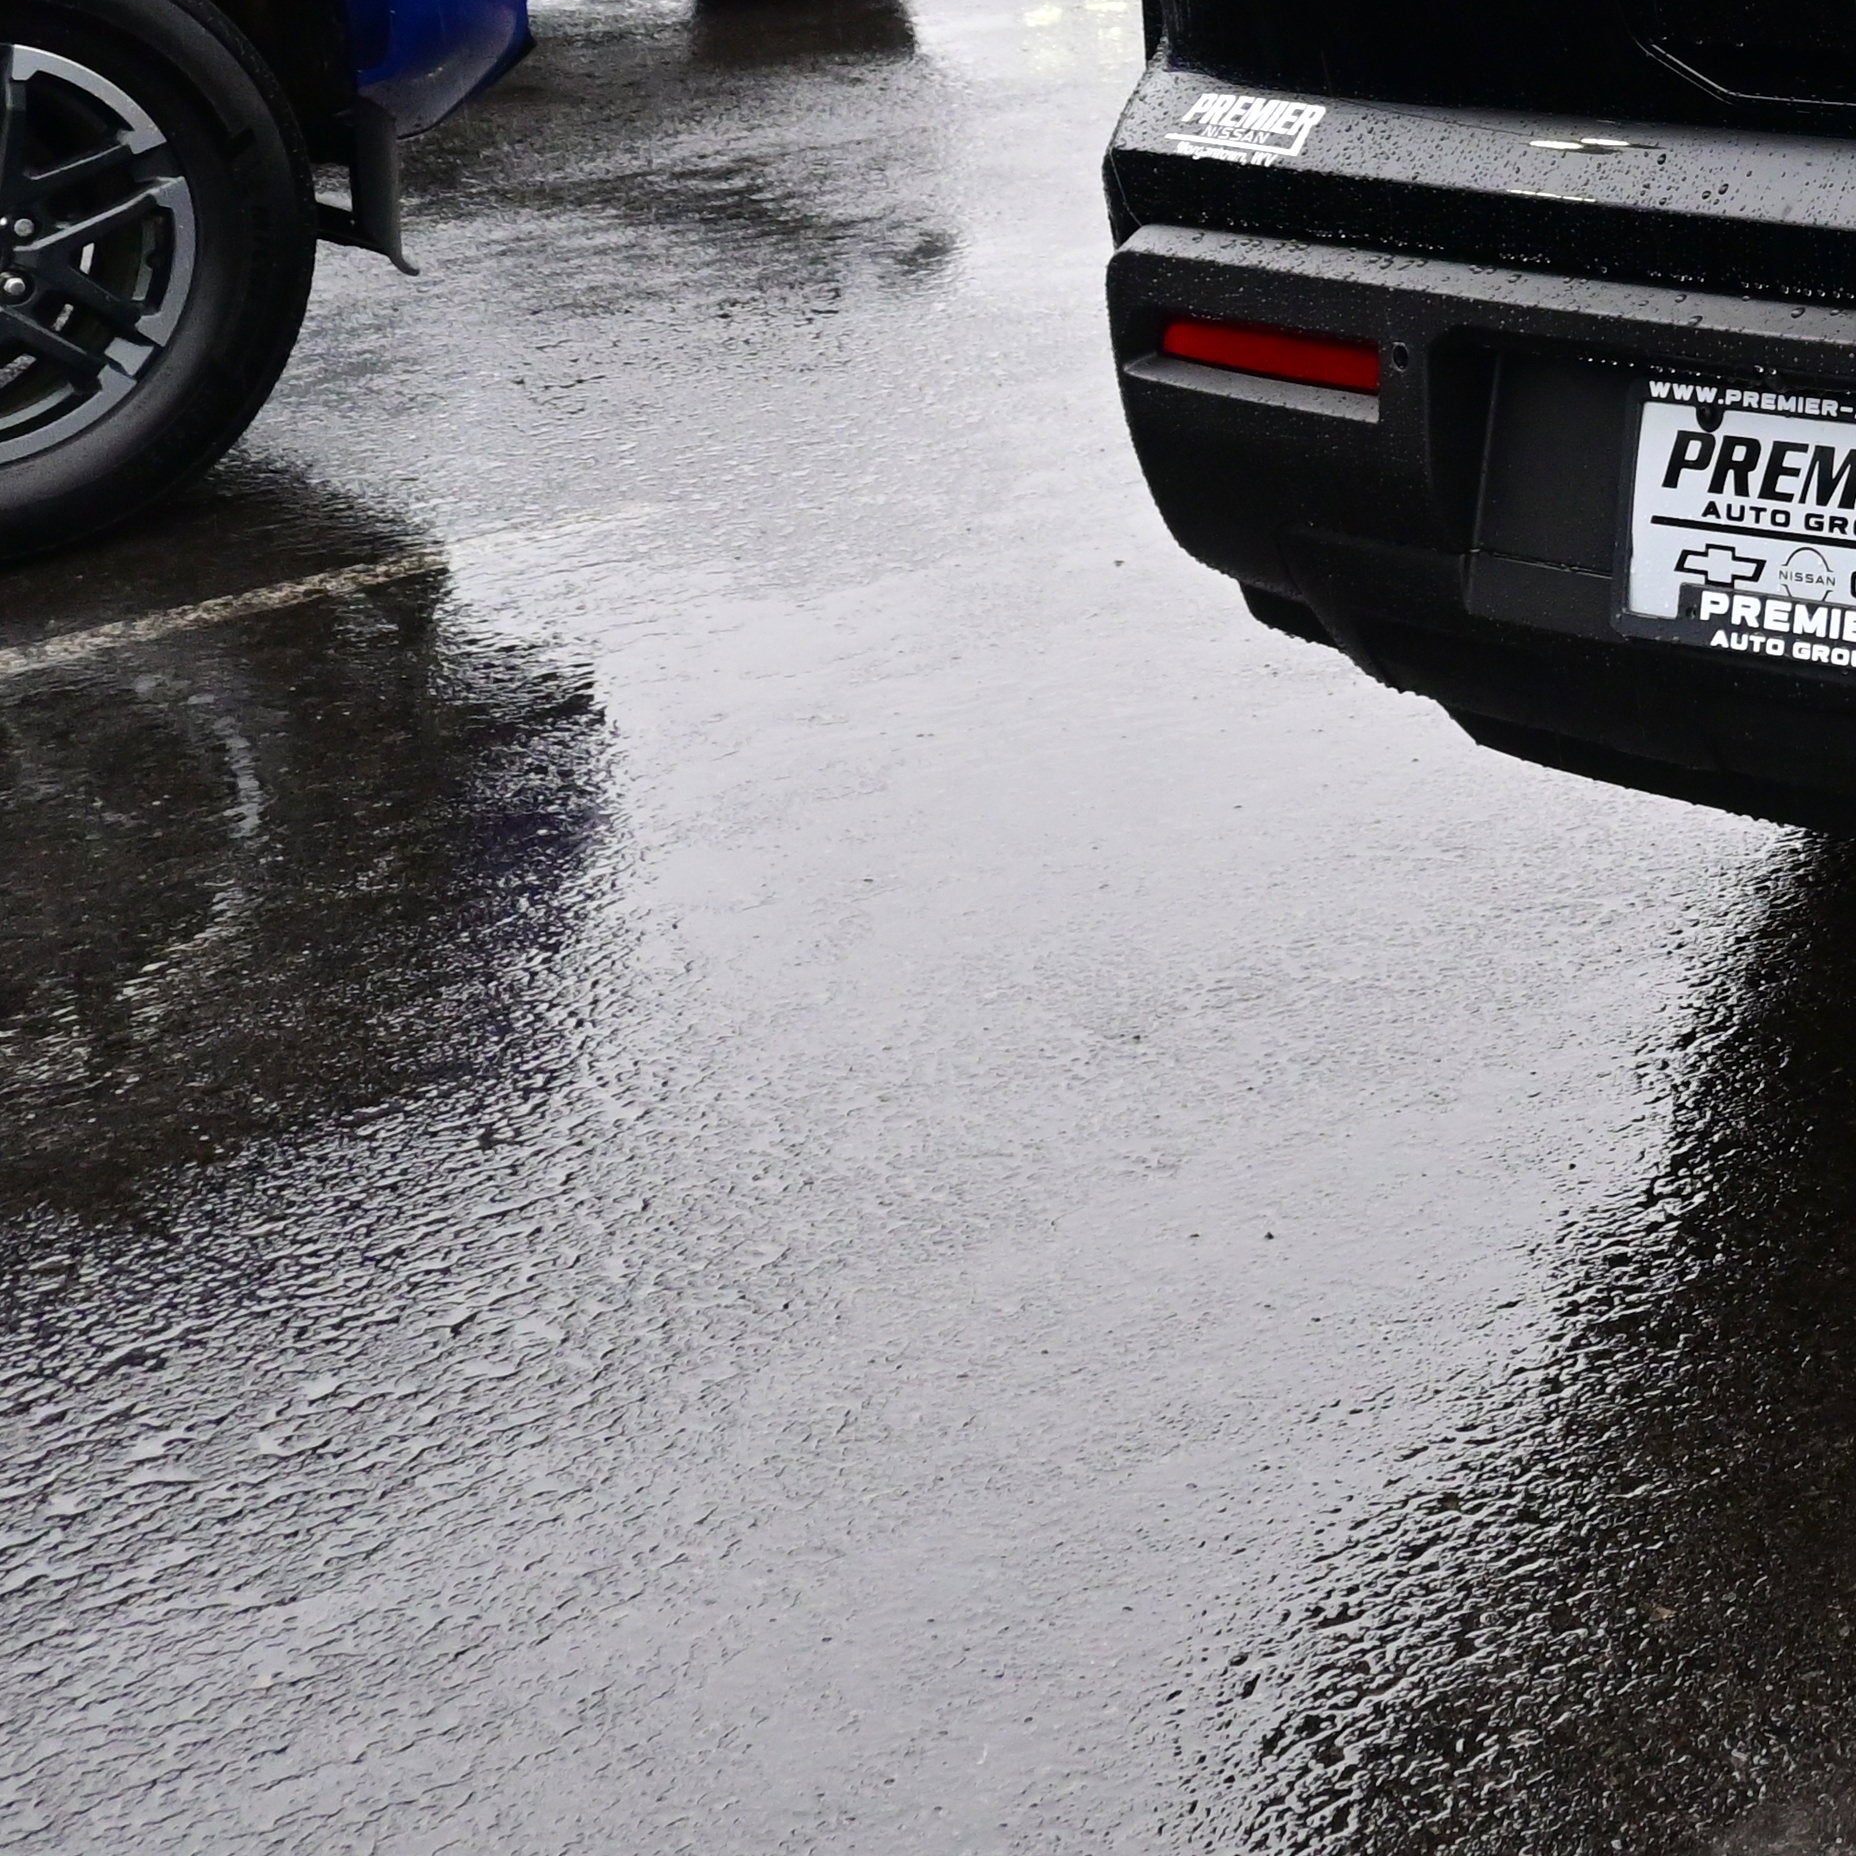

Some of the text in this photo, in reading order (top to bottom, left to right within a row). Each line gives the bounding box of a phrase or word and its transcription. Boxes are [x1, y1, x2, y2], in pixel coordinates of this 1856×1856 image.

[1181, 93, 1326, 136] PREMIER
[1201, 124, 1271, 145] NISSAN
[1250, 151, 1278, 167] WV
[1701, 500, 1791, 529] AUTO
[1777, 570, 1837, 587] NISSAN
[1709, 630, 1785, 657] AUTO
